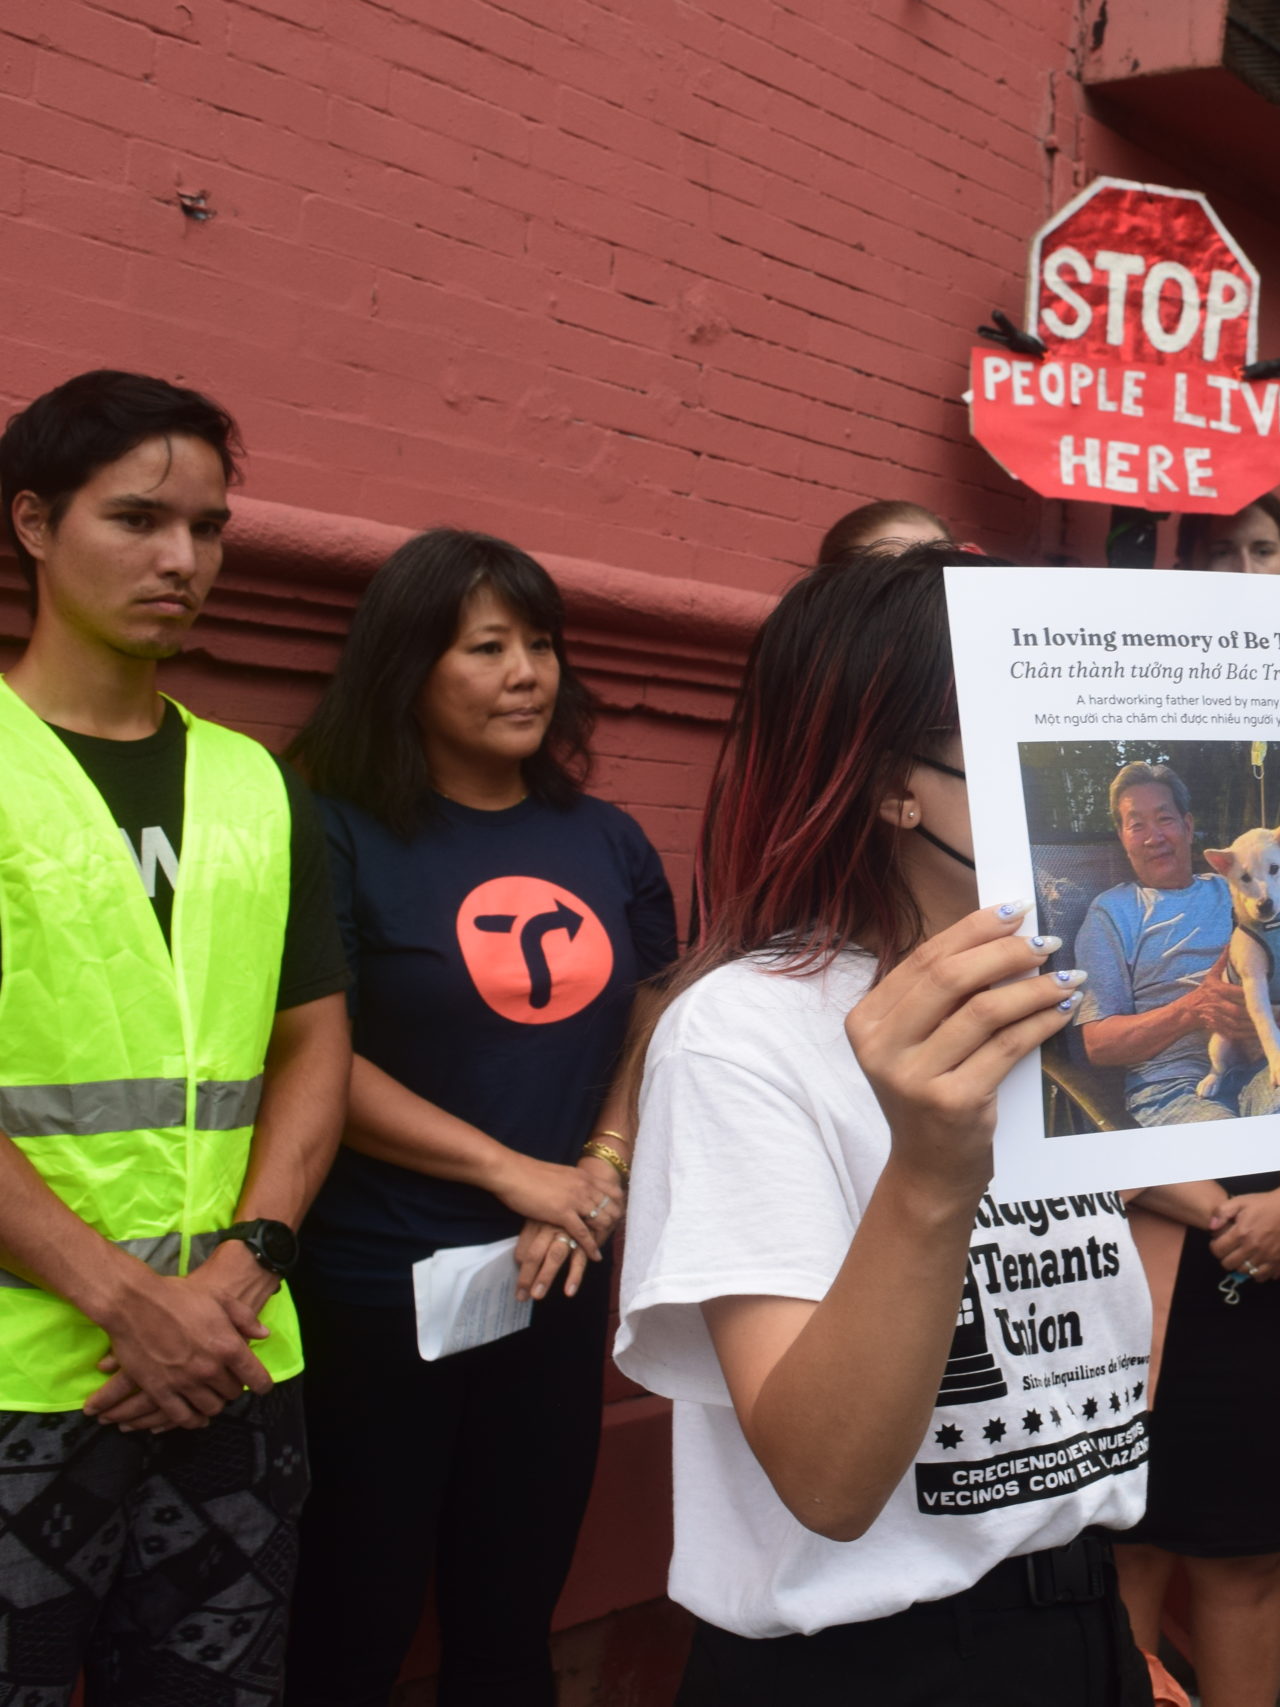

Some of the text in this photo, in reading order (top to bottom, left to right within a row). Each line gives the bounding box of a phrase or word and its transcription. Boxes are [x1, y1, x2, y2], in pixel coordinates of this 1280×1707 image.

[1040, 246, 1249, 361] STOP
[983, 356, 1147, 418] PEOPLE
[1059, 435, 1218, 498] HERE
[1011, 627, 1038, 647] In
[1042, 626, 1118, 652] loving
[1121, 632, 1213, 653] memory
[1217, 630, 1239, 649] of
[1243, 631, 1270, 650] Be
[1010, 660, 1063, 679] Chân
[1068, 660, 1125, 678] thành
[1130, 661, 1184, 685] tưởng
[1188, 661, 1223, 680] nhớ
[1225, 662, 1258, 681] Bác
[1075, 694, 1086, 705] A
[1089, 694, 1163, 708] hardworking
[1165, 694, 1200, 706] father
[1202, 695, 1232, 707] loved
[1234, 695, 1247, 709] by
[1034, 713, 1060, 725] Một
[1101, 712, 1123, 724] cha
[1181, 712, 1208, 726] được
[970, 1235, 1120, 1294] Tenants
[1051, 1363, 1106, 1388] Inquilinos
[923, 1480, 1021, 1507] VECINOS
